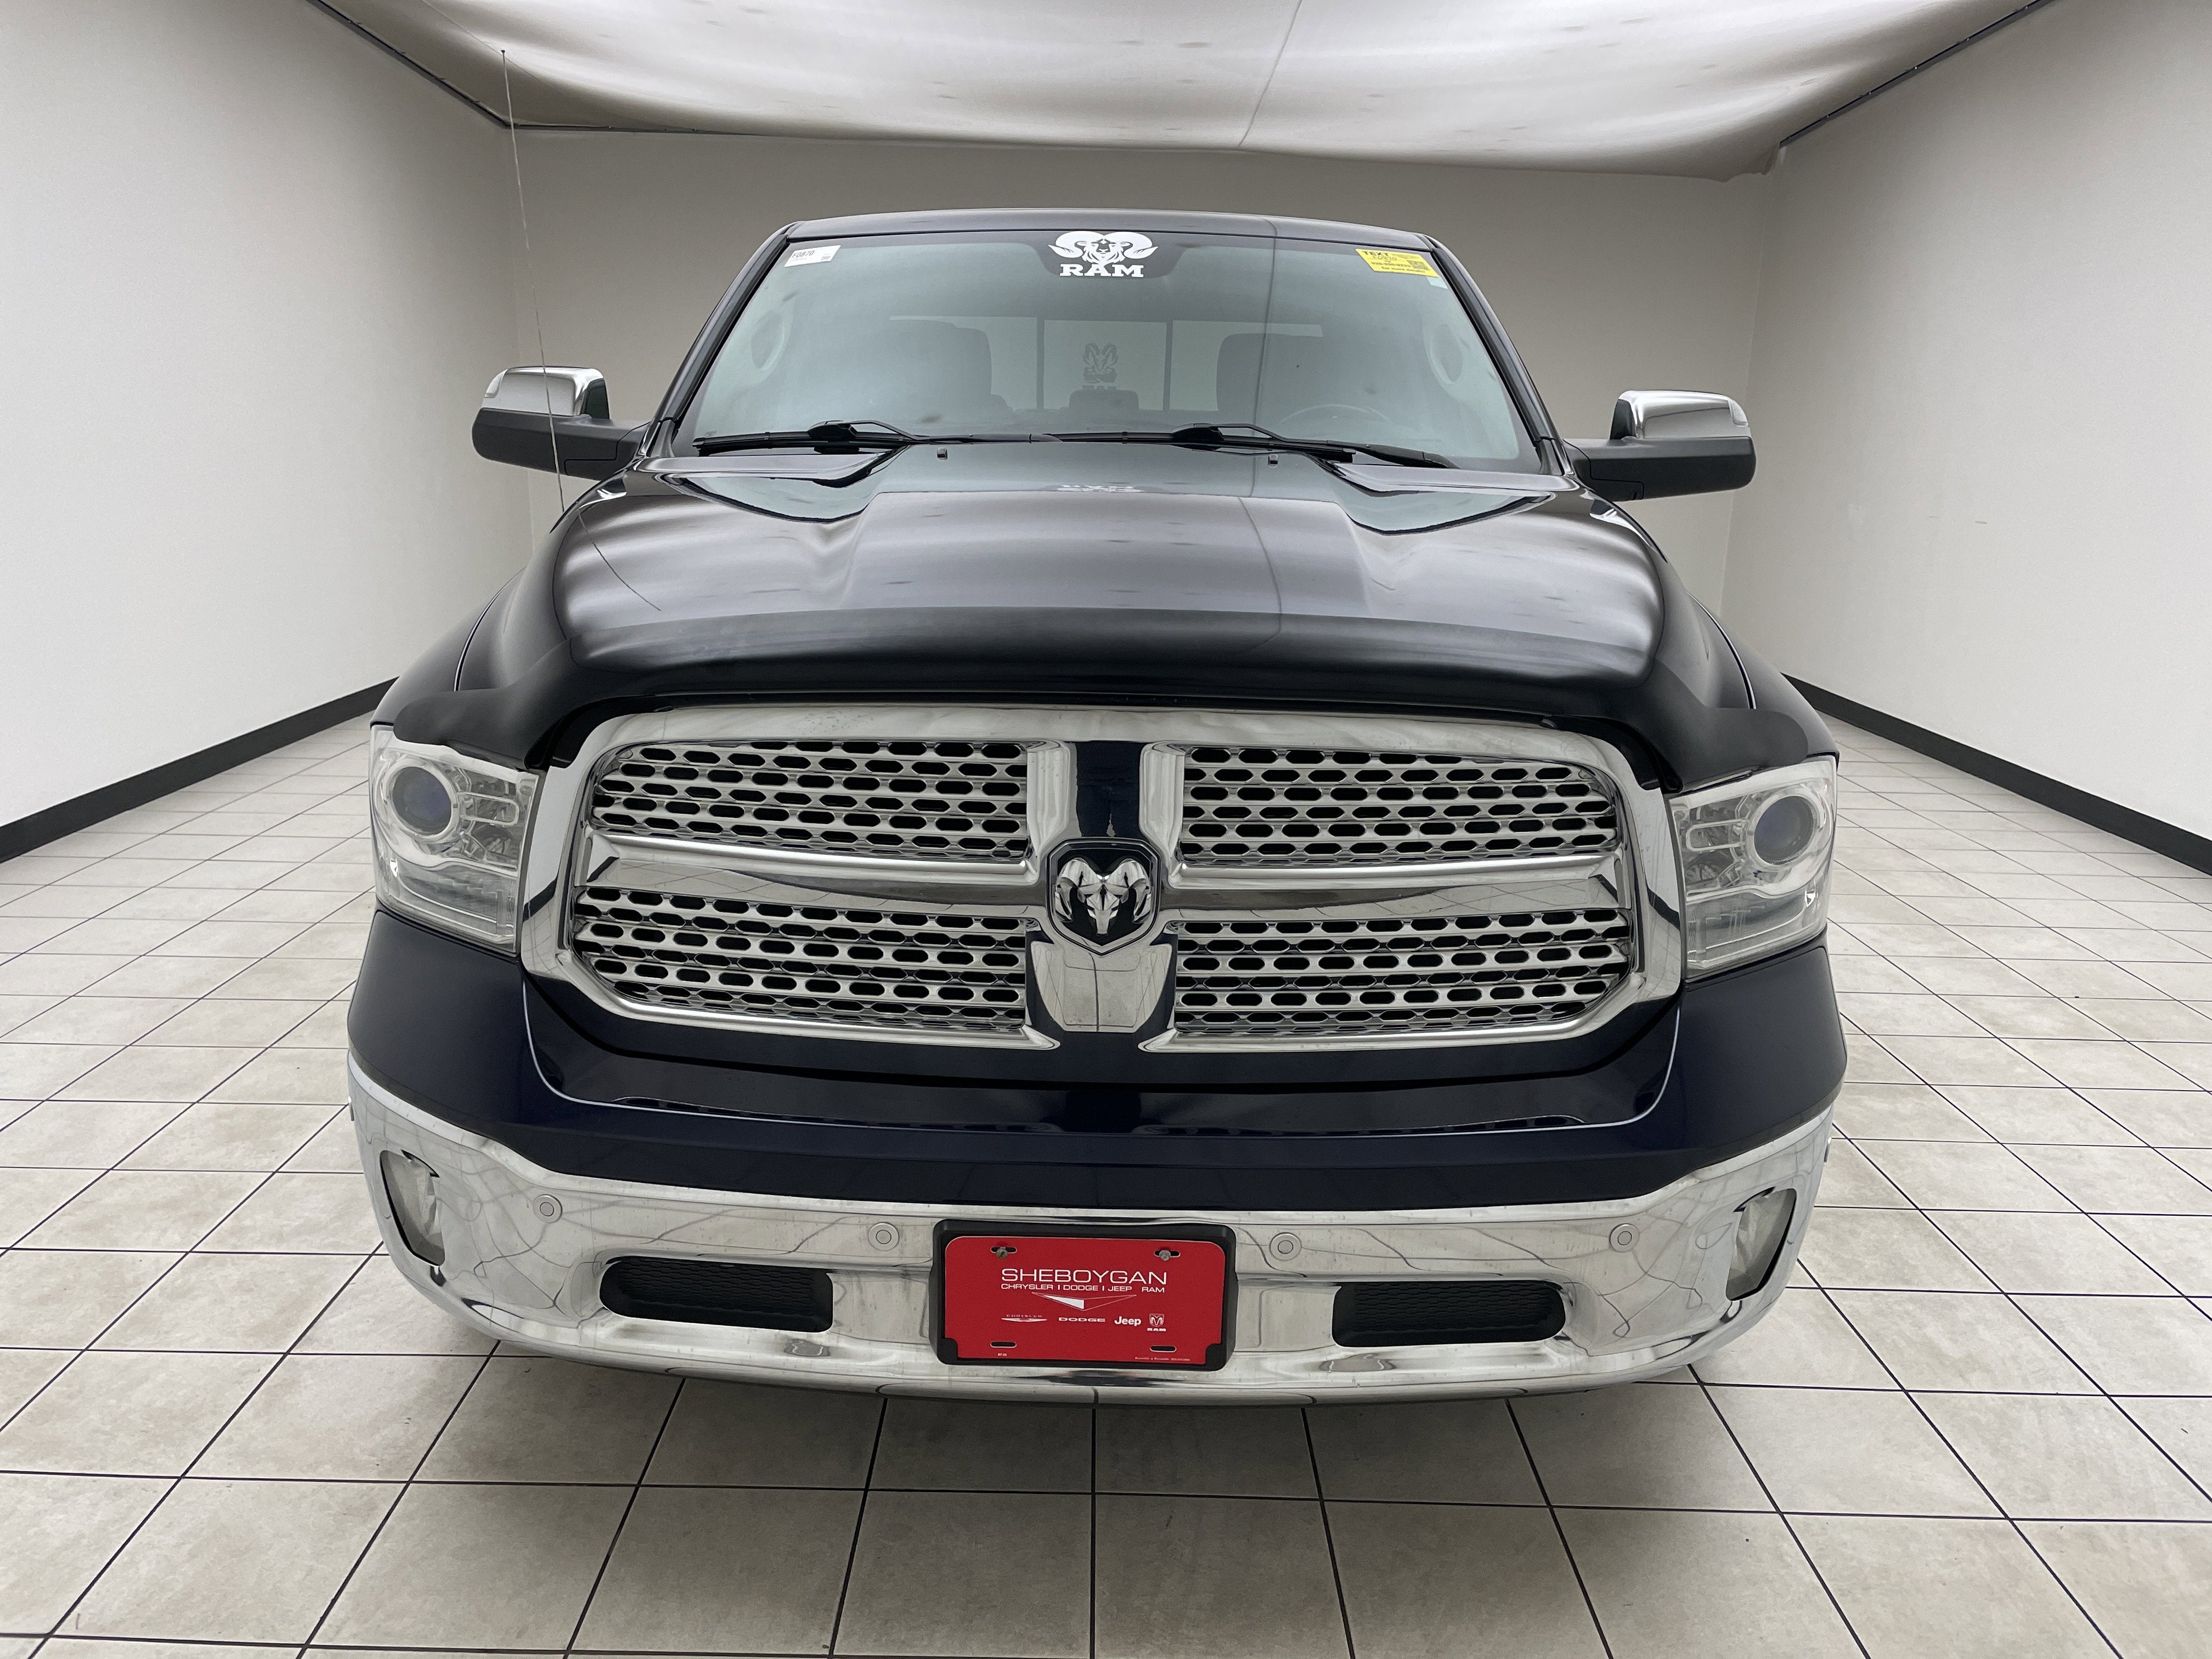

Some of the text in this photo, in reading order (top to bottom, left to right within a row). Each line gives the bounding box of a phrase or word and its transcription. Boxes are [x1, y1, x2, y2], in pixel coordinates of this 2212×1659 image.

[1059, 263, 1144, 278] RAM
[1001, 1268, 1167, 1285] SHEBOYGAN
[1114, 1316, 1142, 1327] Jeep
